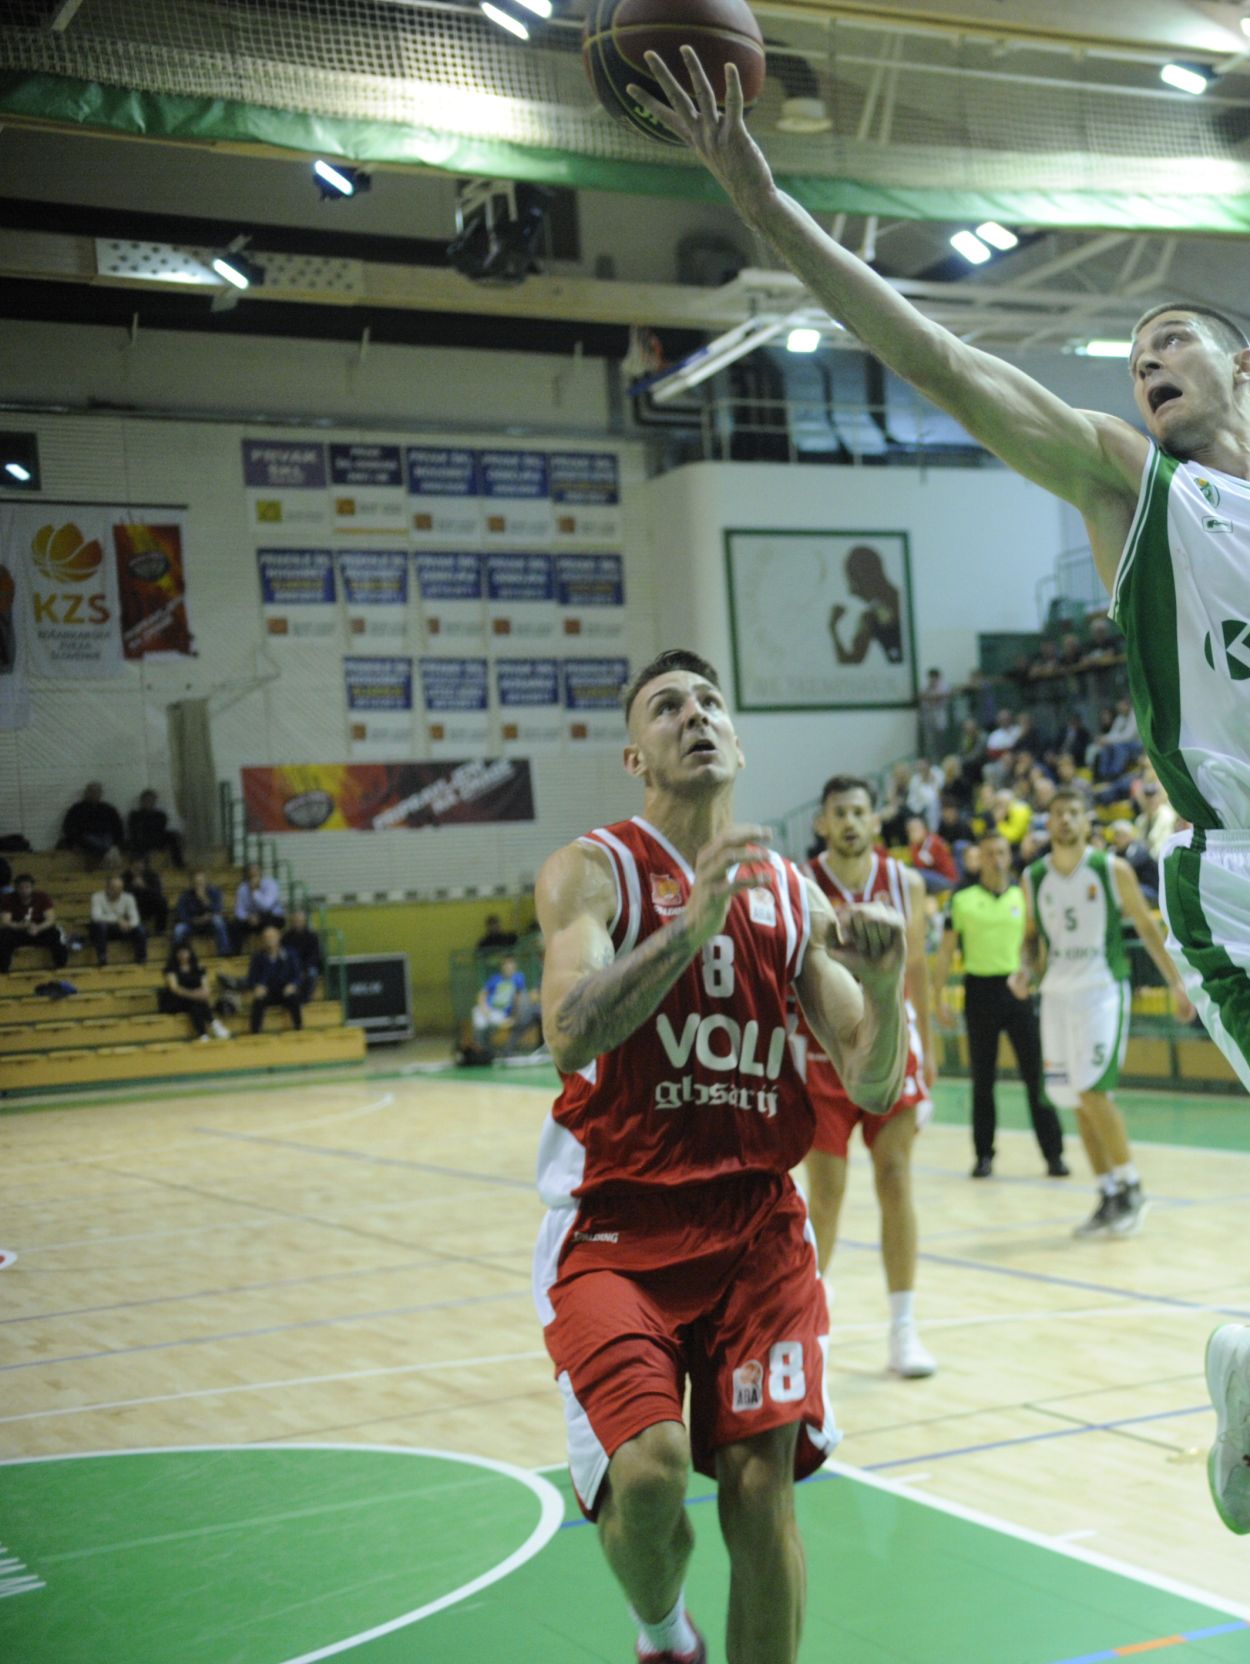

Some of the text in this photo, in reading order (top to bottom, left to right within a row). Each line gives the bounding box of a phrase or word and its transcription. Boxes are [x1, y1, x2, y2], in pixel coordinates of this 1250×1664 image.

[33, 592, 112, 625] KZS
[702, 935, 735, 998] 8
[656, 1012, 786, 1081] VOLI
[769, 1341, 807, 1403] 8
